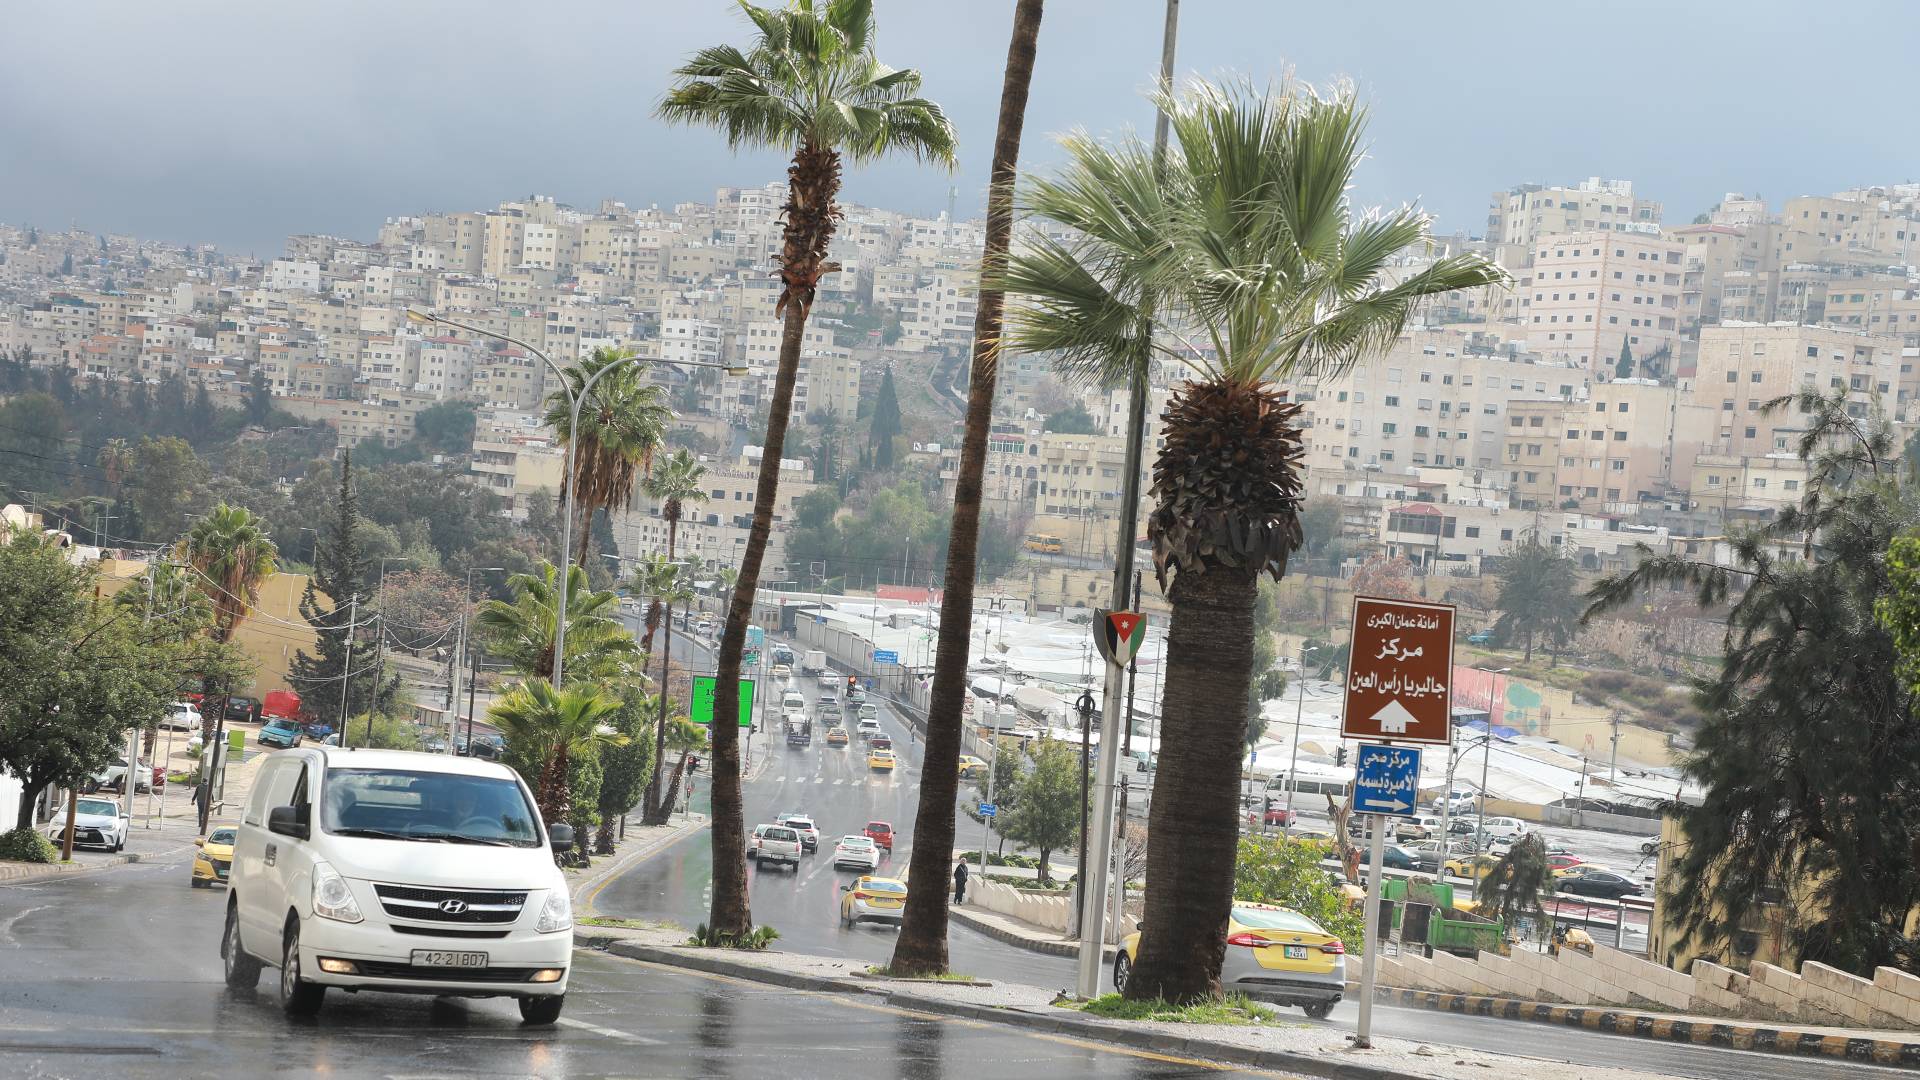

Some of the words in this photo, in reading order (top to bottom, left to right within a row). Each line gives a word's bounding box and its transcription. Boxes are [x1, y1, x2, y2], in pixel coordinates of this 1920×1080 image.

[1367, 612, 1395, 629] الكبرى
[1394, 614, 1415, 630] عمان
[1417, 614, 1439, 630] أمانة
[1374, 637, 1423, 662] مركز
[1350, 671, 1377, 693] العين
[1378, 667, 1401, 695] رأس
[1404, 673, 1446, 699] جاليريا
[1363, 752, 1387, 769] صحي
[1387, 750, 1410, 769] مركز
[1358, 768, 1384, 794] بسمة
